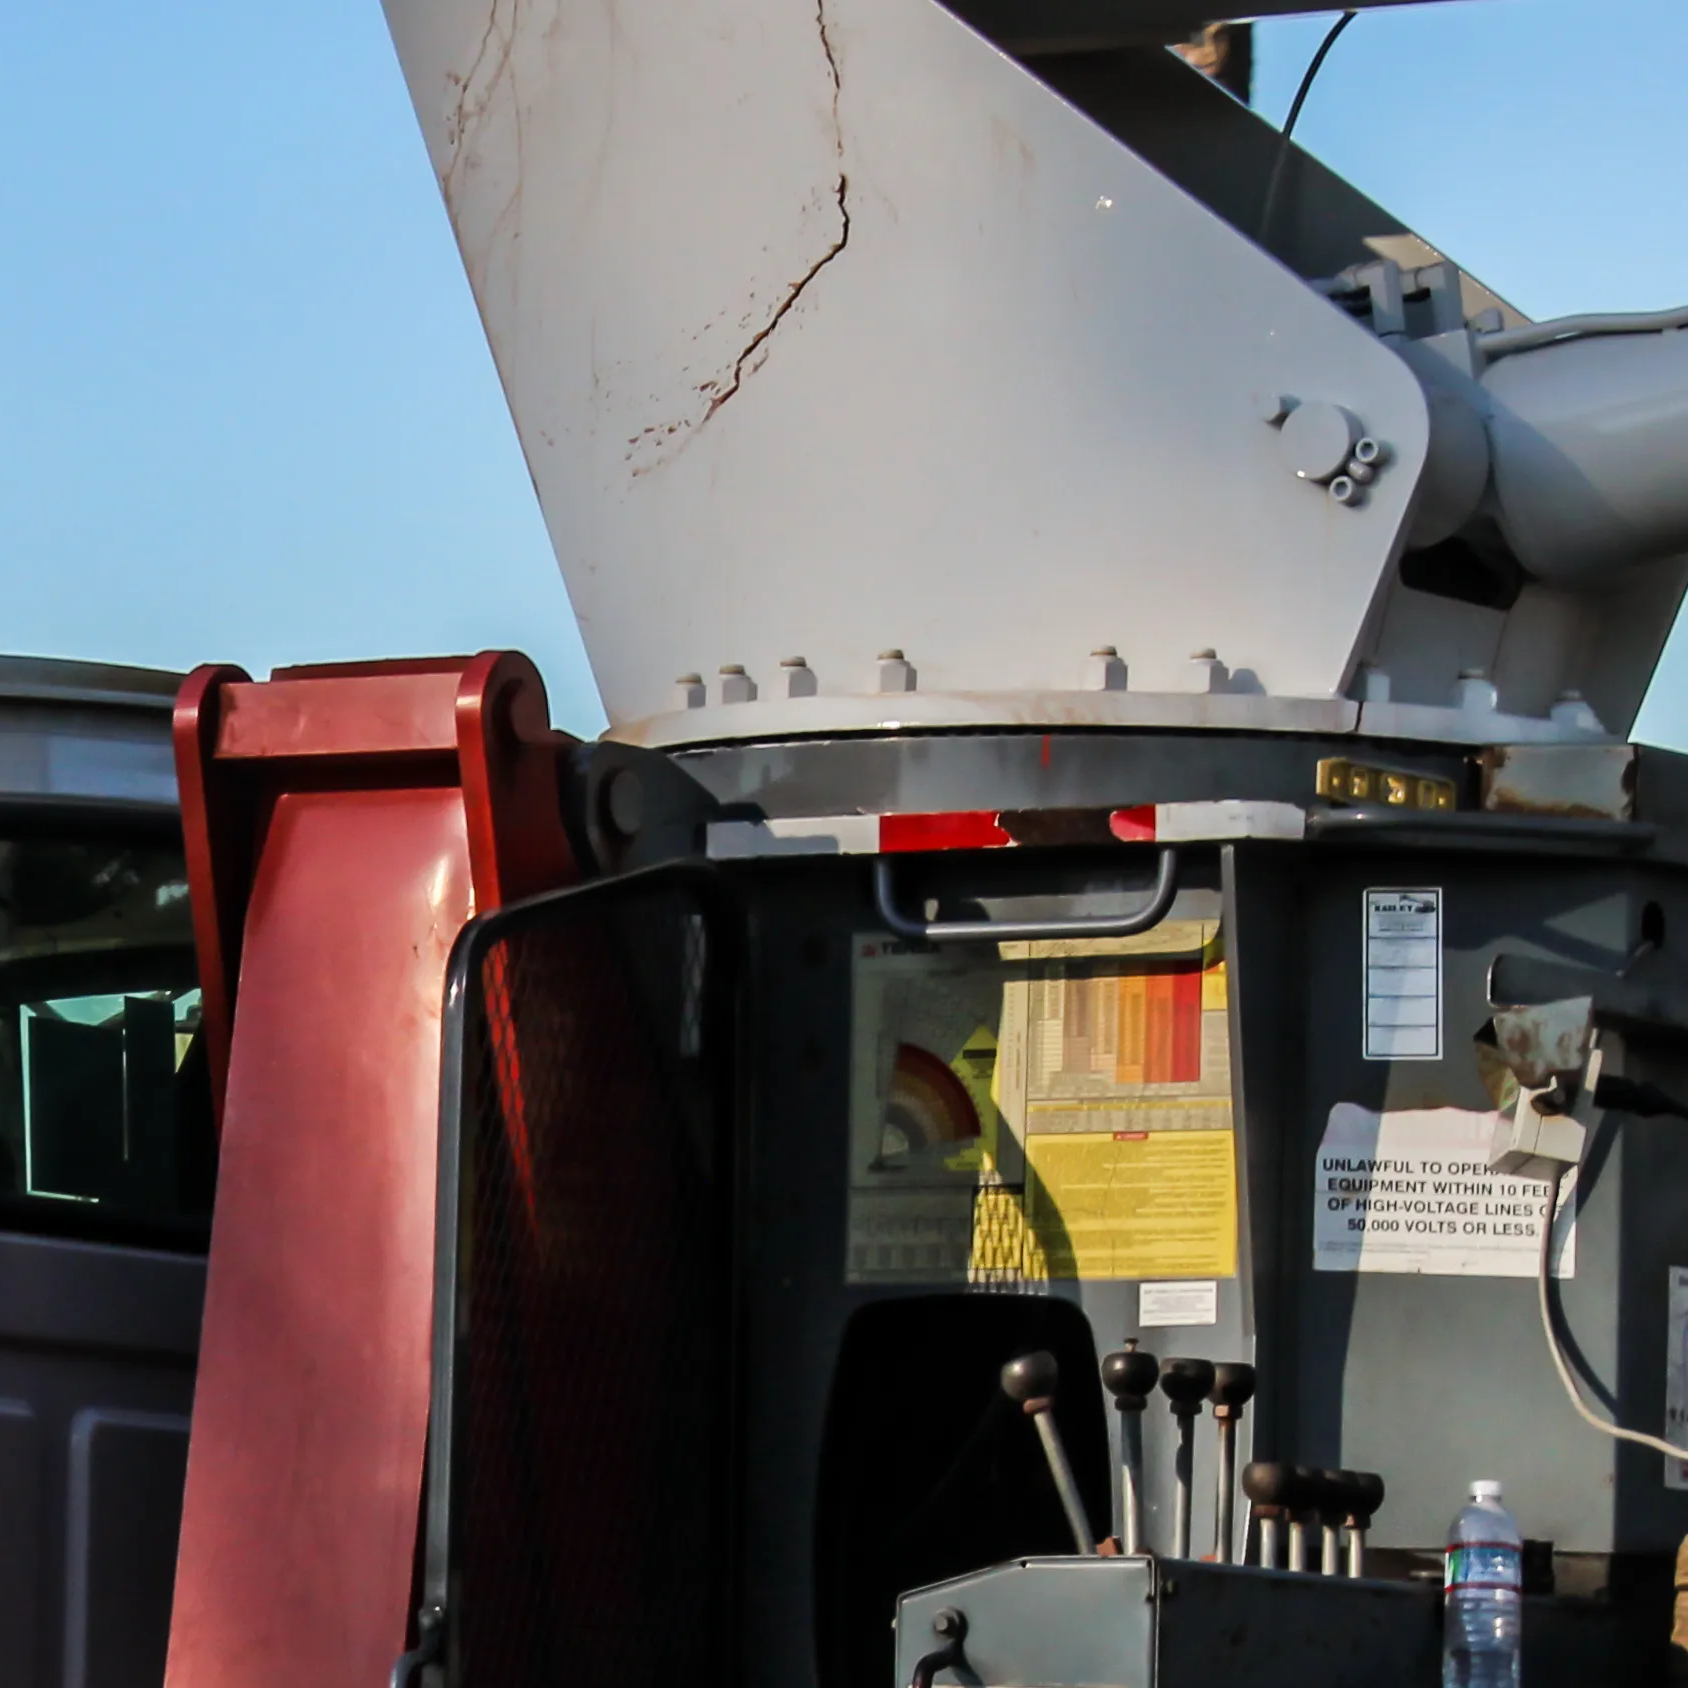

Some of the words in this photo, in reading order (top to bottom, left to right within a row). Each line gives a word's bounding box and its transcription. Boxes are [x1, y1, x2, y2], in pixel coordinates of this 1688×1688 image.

[1323, 1158, 1414, 1174] UNLAWFUL
[1421, 1162, 1442, 1175] TO
[1327, 1177, 1427, 1193] EQUIPMENT
[1433, 1181, 1493, 1196] WITHIN
[1500, 1184, 1517, 1196] 10
[1327, 1197, 1351, 1211] OF
[1355, 1198, 1479, 1214] HIGH-VOLTAGE
[1485, 1203, 1534, 1217] LINES
[1347, 1218, 1399, 1232] 50,000
[1404, 1220, 1457, 1234] VOLTS
[1463, 1222, 1487, 1235] OR
[1493, 1223, 1540, 1237] LESS.
